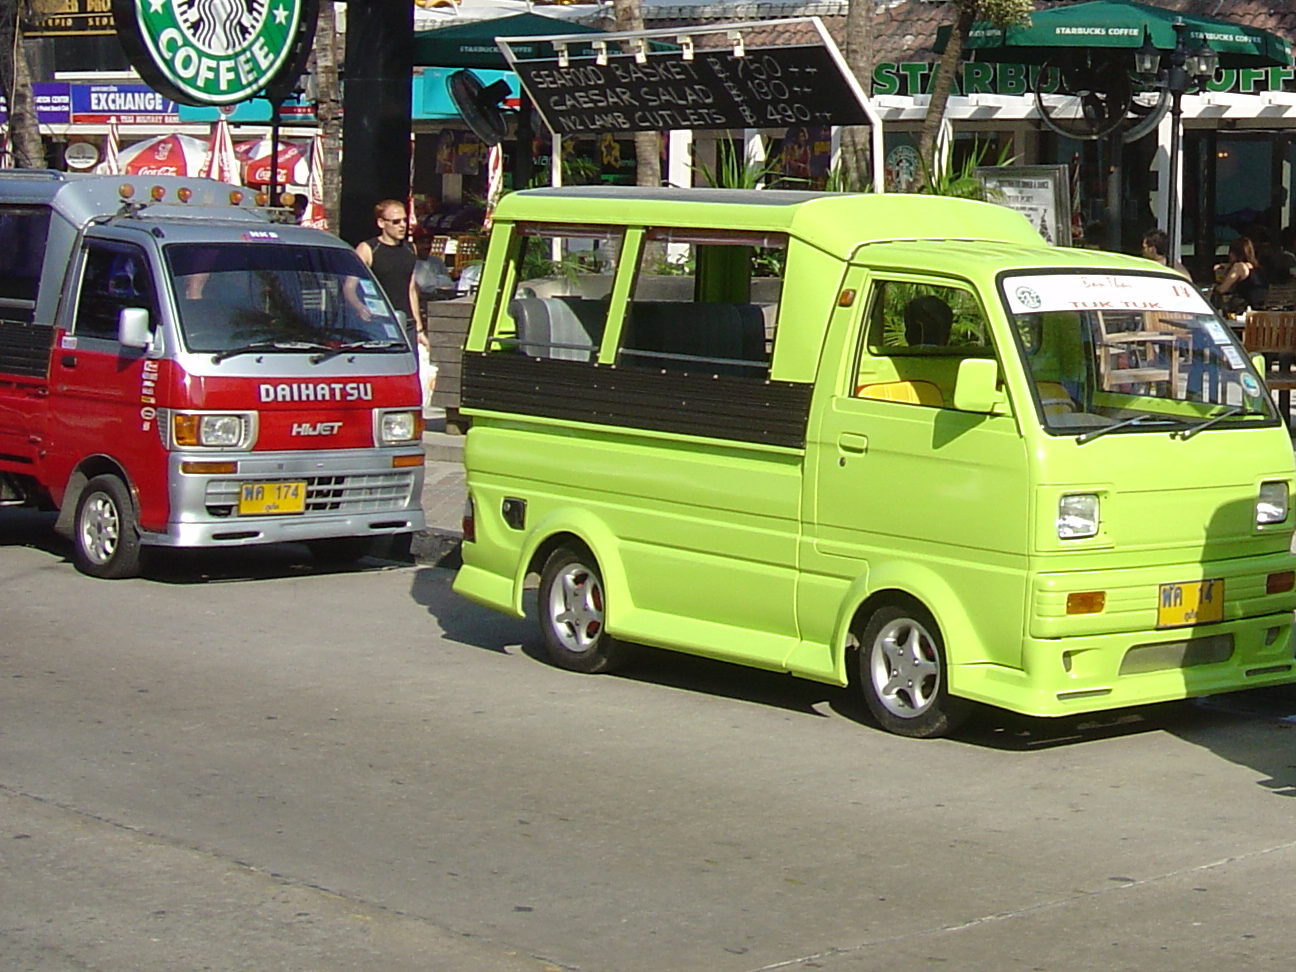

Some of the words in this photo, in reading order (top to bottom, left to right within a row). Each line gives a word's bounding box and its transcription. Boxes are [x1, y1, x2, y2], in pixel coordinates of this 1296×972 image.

[1055, 27, 1107, 35] STARBUCKS
[1108, 28, 1139, 36] COFFEE
[1190, 32, 1234, 42] STARBUCKS
[158, 28, 275, 91] COFFEE
[531, 65, 605, 88] SEAFOOD
[611, 60, 698, 83] BASKET
[727, 54, 782, 79] 750
[91, 92, 163, 111] EXCHANGE
[551, 87, 640, 111] CAESAR
[641, 84, 714, 107] SALAD
[747, 79, 790, 101] 190
[583, 111, 631, 129] LAMB
[634, 108, 727, 127] CUTLETS
[766, 102, 811, 124] 490
[1068, 301, 1114, 309] TUK
[1119, 301, 1163, 310] TUK
[259, 382, 373, 402] DAIHATSU
[275, 484, 299, 500] 174
